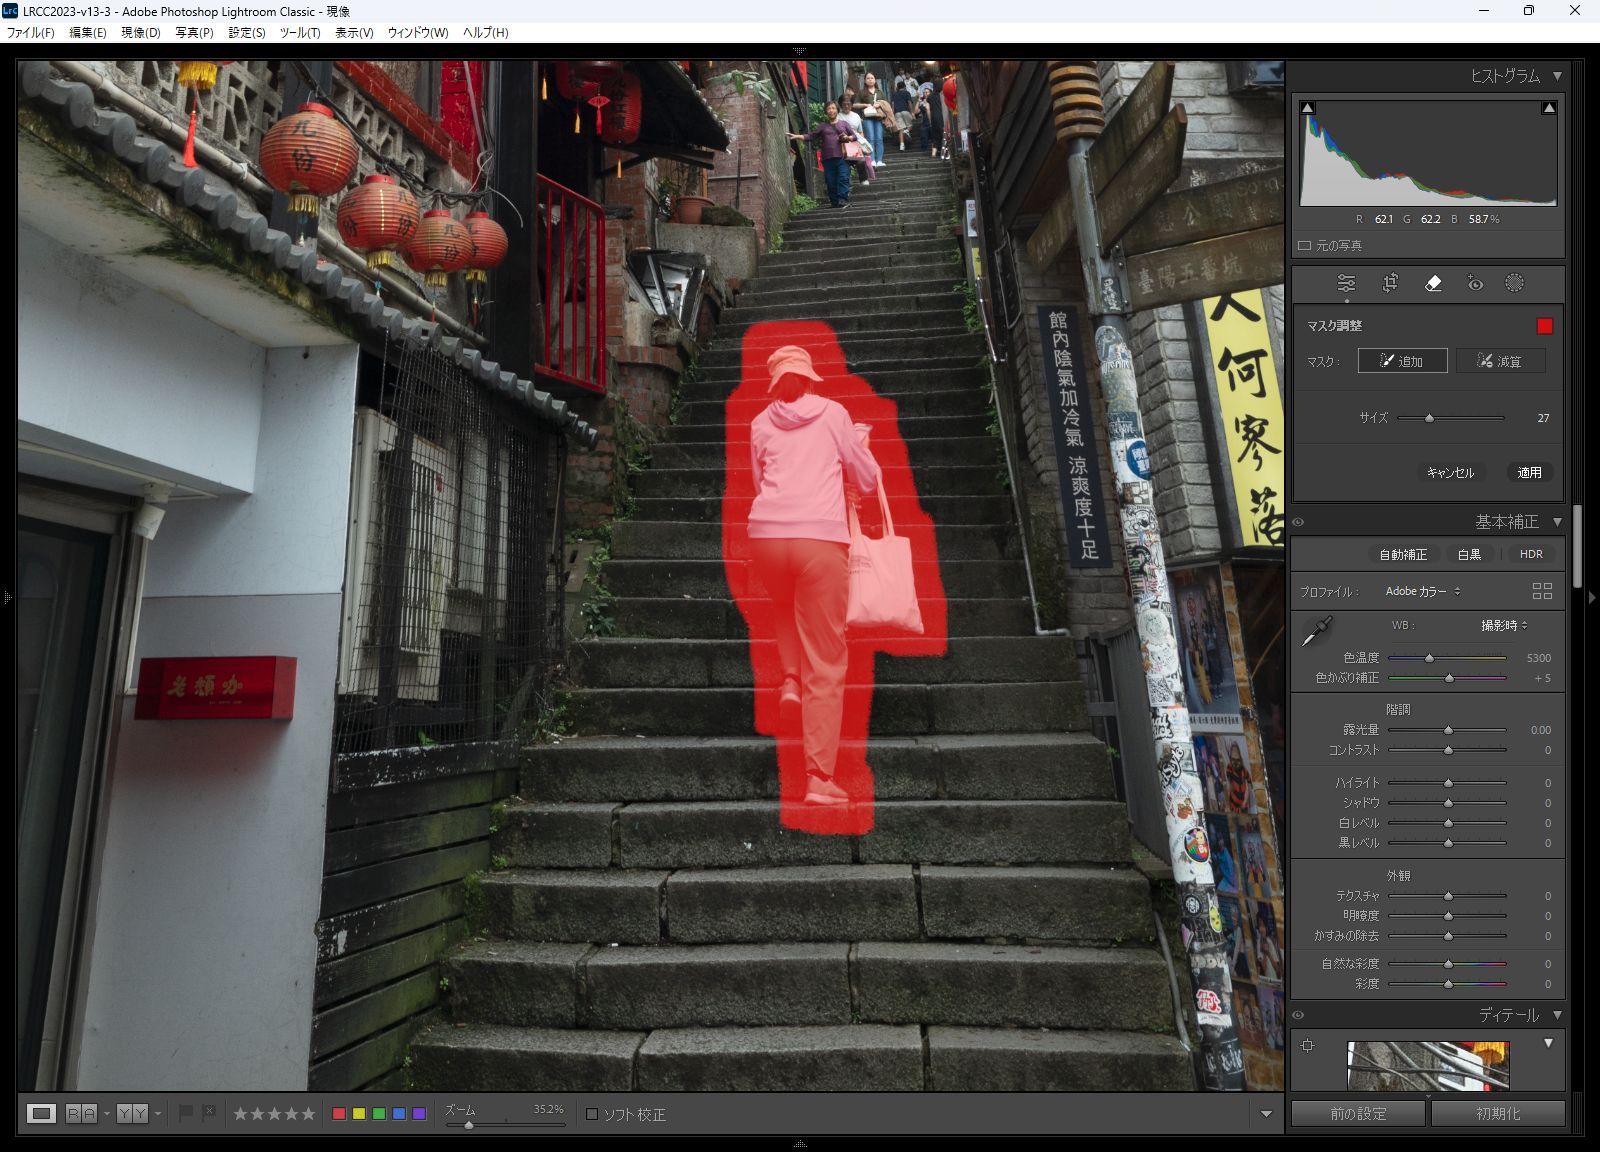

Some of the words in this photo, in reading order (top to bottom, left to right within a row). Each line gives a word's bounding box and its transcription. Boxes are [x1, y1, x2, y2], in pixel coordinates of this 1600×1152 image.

[23, 6, 111, 17] LRCC2023-v13-3
[121, 6, 158, 17] Adobe
[160, 6, 219, 20] Photoshop
[221, 6, 277, 20] Lightroom
[279, 6, 316, 17] Classic
[326, 5, 351, 18] 現像
[7, 26, 55, 40] ファイル(F)
[68, 26, 107, 40] 編集(E)
[121, 26, 161, 40] 現像(D)
[175, 26, 214, 40] 写真(P)
[227, 26, 266, 40] 設定(S)
[279, 26, 321, 40] ツール(T)
[334, 26, 374, 40] 表示(V)
[388, 25, 449, 40] ウィンドウ(W)
[463, 25, 509, 40] ヘルプ(H)
[1472, 67, 1541, 84] ヒストグラム
[1356, 214, 1364, 224] R
[1374, 214, 1393, 224] 62.1
[1402, 214, 1411, 224] G
[1420, 214, 1441, 224] 62.2
[1451, 214, 1458, 224] B
[1316, 239, 1363, 252] 元の写真
[1307, 319, 1363, 332] マスク調整
[1398, 355, 1423, 368] 追加
[1497, 354, 1523, 368] 減算
[1359, 411, 1389, 424] サイズ
[1537, 413, 1550, 423] 27
[1427, 466, 1475, 479] キャンセル
[1517, 466, 1542, 479] 適用
[1475, 513, 1540, 530] 基本補正
[1380, 548, 1428, 561] 自動補正
[1458, 548, 1482, 561] 白黒
[1520, 549, 1544, 559] HDR
[1385, 585, 1418, 596] Adobe
[1420, 587, 1447, 598] カラー
[1481, 619, 1518, 632] 撮影時
[1343, 651, 1380, 664] 色温度
[1527, 653, 1552, 663] 5300
[1315, 671, 1380, 685] 色かぶり補正
[1386, 703, 1411, 717] 階調
[1343, 723, 1380, 736] 露光量
[1530, 725, 1552, 735] 0.00
[1329, 743, 1380, 756] コントラスト
[1544, 745, 1552, 755] 0
[1335, 776, 1380, 789] ハイライト
[1544, 778, 1552, 788] 0
[1343, 796, 1381, 809] シャドウ
[1544, 798, 1552, 808] 0
[1339, 816, 1380, 829] 白レベル
[1544, 818, 1552, 828] 0
[1338, 836, 1380, 849] 黒レベル
[1544, 838, 1552, 848] 0
[1386, 869, 1411, 882] 外観
[1336, 889, 1380, 902] テクスチャ
[1544, 891, 1552, 901] 0
[1343, 909, 1380, 923] 明瞭度
[1544, 911, 1552, 921] 0
[1314, 929, 1380, 942] かすみの除去
[1544, 931, 1552, 941] 0
[1322, 957, 1380, 971] 自然な彩度
[1544, 959, 1552, 969] 0
[1355, 977, 1380, 990] 彩度
[1544, 979, 1552, 989] 0
[1479, 1006, 1540, 1023] ディテール
[445, 1103, 476, 1116] ズーム
[533, 1104, 565, 1114] 35.2%
[1330, 1104, 1387, 1121] 前の設定
[1476, 1104, 1521, 1121] 初期化
